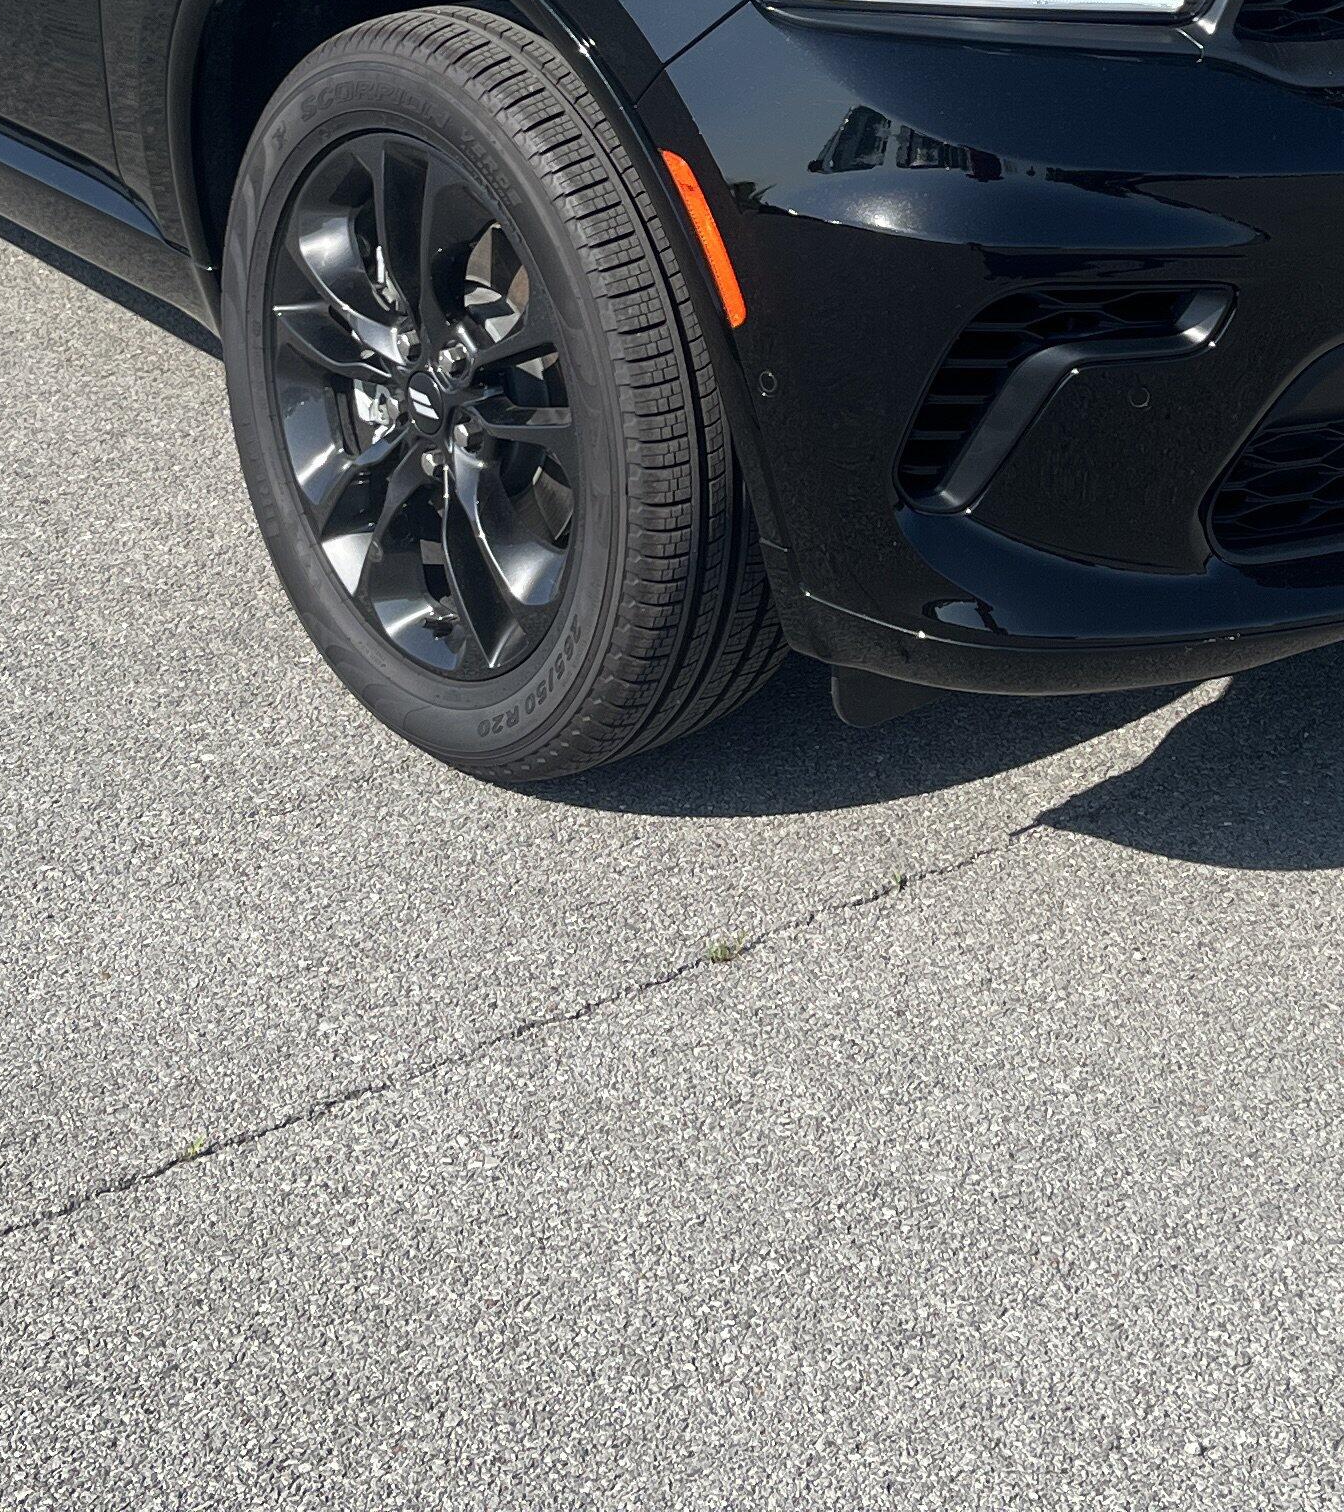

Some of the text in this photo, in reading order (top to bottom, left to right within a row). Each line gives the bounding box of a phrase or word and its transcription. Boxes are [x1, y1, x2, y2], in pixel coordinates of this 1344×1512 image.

[300, 78, 453, 131] SCORPION
[476, 613, 582, 738] 265/50 R20
